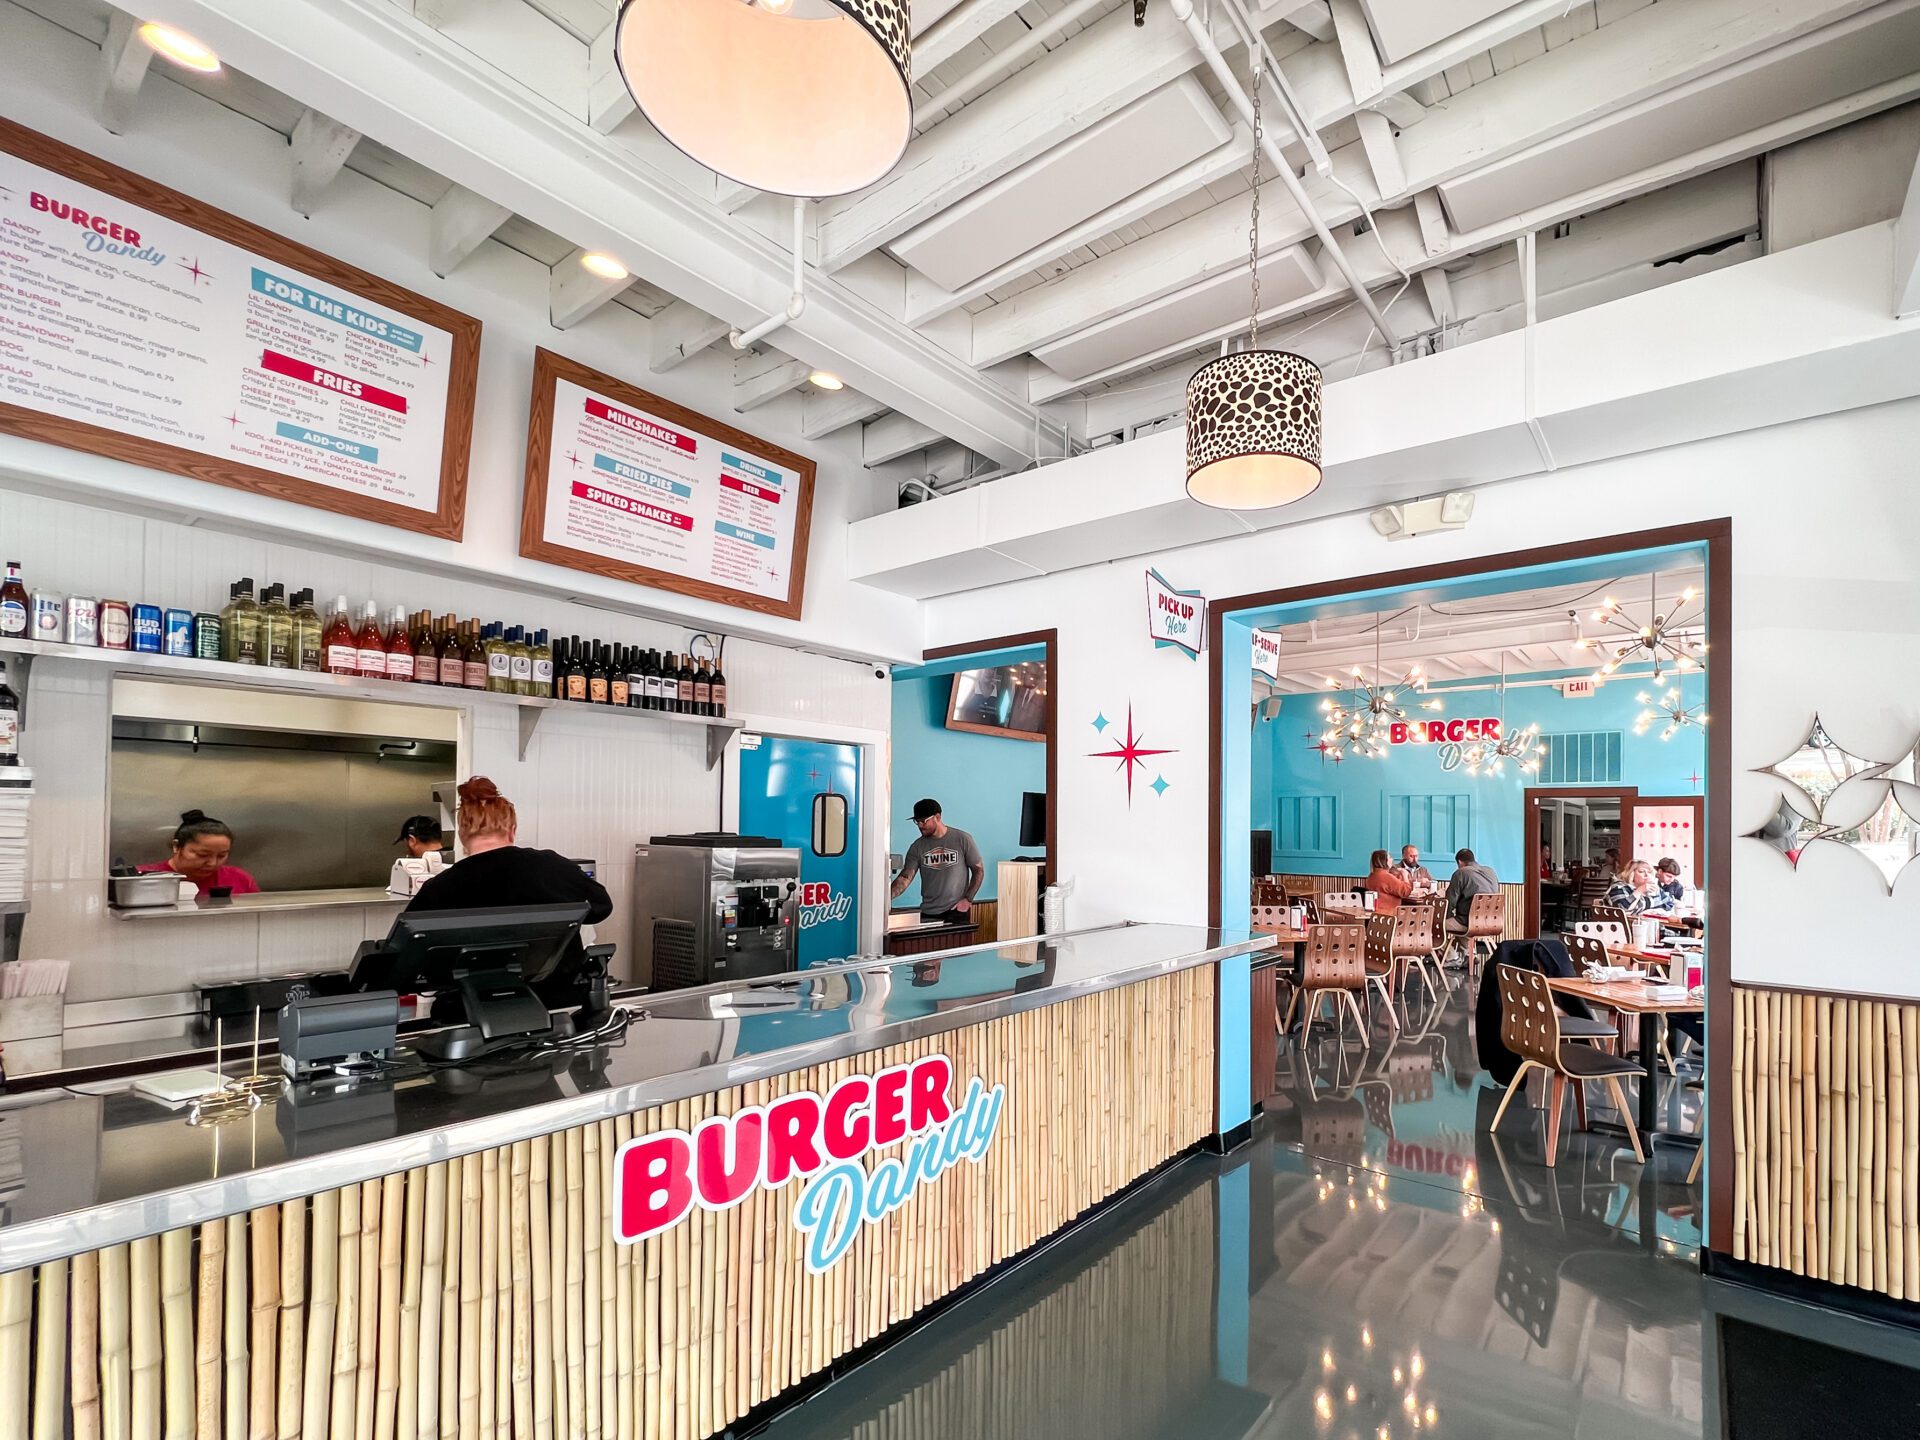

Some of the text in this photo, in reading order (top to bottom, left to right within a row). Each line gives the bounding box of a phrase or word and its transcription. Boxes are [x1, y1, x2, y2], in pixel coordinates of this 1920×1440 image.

[2, 217, 41, 235] DANDY
[30, 191, 141, 248] BURGER
[0, 249, 29, 263] ANDY
[23, 242, 58, 260] burger
[94, 268, 114, 280] 6.59
[82, 231, 167, 266] Dandy
[9, 228, 45, 246] burger
[48, 244, 69, 255] with
[71, 251, 120, 275] American,
[122, 270, 170, 292] Coca-Cola
[171, 289, 203, 304] onions,
[9, 272, 58, 293] signature
[60, 288, 93, 304] burger
[9, 263, 200, 332] smash burger with American, Coca-Cola
[17, 288, 61, 308] BURGER
[264, 299, 293, 313] DANDY
[264, 278, 387, 335] FOR THE KIDS
[10, 304, 35, 317] herb
[84, 329, 118, 343] pickled
[120, 340, 146, 352] onion
[16, 321, 74, 344] SANDWICH
[39, 306, 63, 318] corn
[65, 314, 95, 328] patty,
[147, 340, 175, 353] mixed
[176, 350, 208, 364] greens,
[245, 324, 260, 334] Full
[271, 335, 298, 349] cheesy
[246, 317, 311, 345] GRILLED CHEESE
[346, 330, 377, 346] CHICKEN
[378, 342, 398, 353] BITES
[0, 339, 24, 352] DOG
[0, 325, 35, 340] hicken
[74, 348, 89, 357] dill
[91, 353, 125, 368] pickles,
[127, 364, 155, 376] mayo
[0, 348, 29, 362] -beef
[31, 359, 55, 371] dog,
[57, 365, 87, 379] house
[88, 375, 110, 386] chili,
[112, 380, 140, 394] house
[142, 390, 162, 400] slaw
[344, 352, 377, 369] HOT DOG
[241, 373, 267, 387] Crispy
[242, 367, 319, 396] CRINKLE-CUT FRIES
[313, 369, 362, 396] FRIES
[7, 375, 180, 428] grilled chicken, mixed greens, bacon,
[240, 391, 271, 405] Loaded
[241, 384, 296, 405] CHEESE FRIES
[6, 384, 30, 395] egg,
[32, 390, 55, 401] blue
[95, 408, 129, 421] pickled
[130, 417, 158, 430] onion,
[160, 425, 185, 436] ranch
[340, 398, 406, 424] CHILI CHEESE FRIES
[607, 409, 677, 444] MILKSHAKES
[244, 431, 282, 445] KOOL-AID
[283, 441, 313, 454] PICKLES
[329, 454, 369, 470] COCA-COLA
[370, 466, 396, 477] ONIONS
[303, 432, 359, 454] ADD-ONS
[230, 444, 262, 457] BURGER
[264, 453, 288, 464] SAUCE
[303, 464, 340, 478] AMERICAN
[341, 474, 367, 485] CHEESE
[382, 485, 405, 495] BACON
[260, 443, 285, 455] FRESH
[286, 450, 320, 465] LETTUCE,
[323, 460, 352, 473] TOMATO
[359, 471, 382, 481] ONION
[739, 461, 765, 477] DRINKS
[615, 463, 648, 482] FRIED
[649, 475, 672, 490] PIES
[742, 483, 759, 496] BEER
[586, 487, 628, 509] SPIKED
[629, 501, 672, 523] SHAKES
[736, 529, 755, 541] WINE
[1158, 592, 1194, 620] PICK UP
[134, 618, 160, 628] BUD
[1165, 615, 1188, 636] Here
[244, 642, 253, 650] H
[276, 645, 285, 654] H
[308, 649, 316, 658] H
[1251, 632, 1278, 656] LF-SERVE
[924, 853, 956, 865] TWINE
[800, 891, 853, 928] andy
[619, 1057, 952, 1240] BURGER
[797, 1078, 1004, 1271] Dandy
